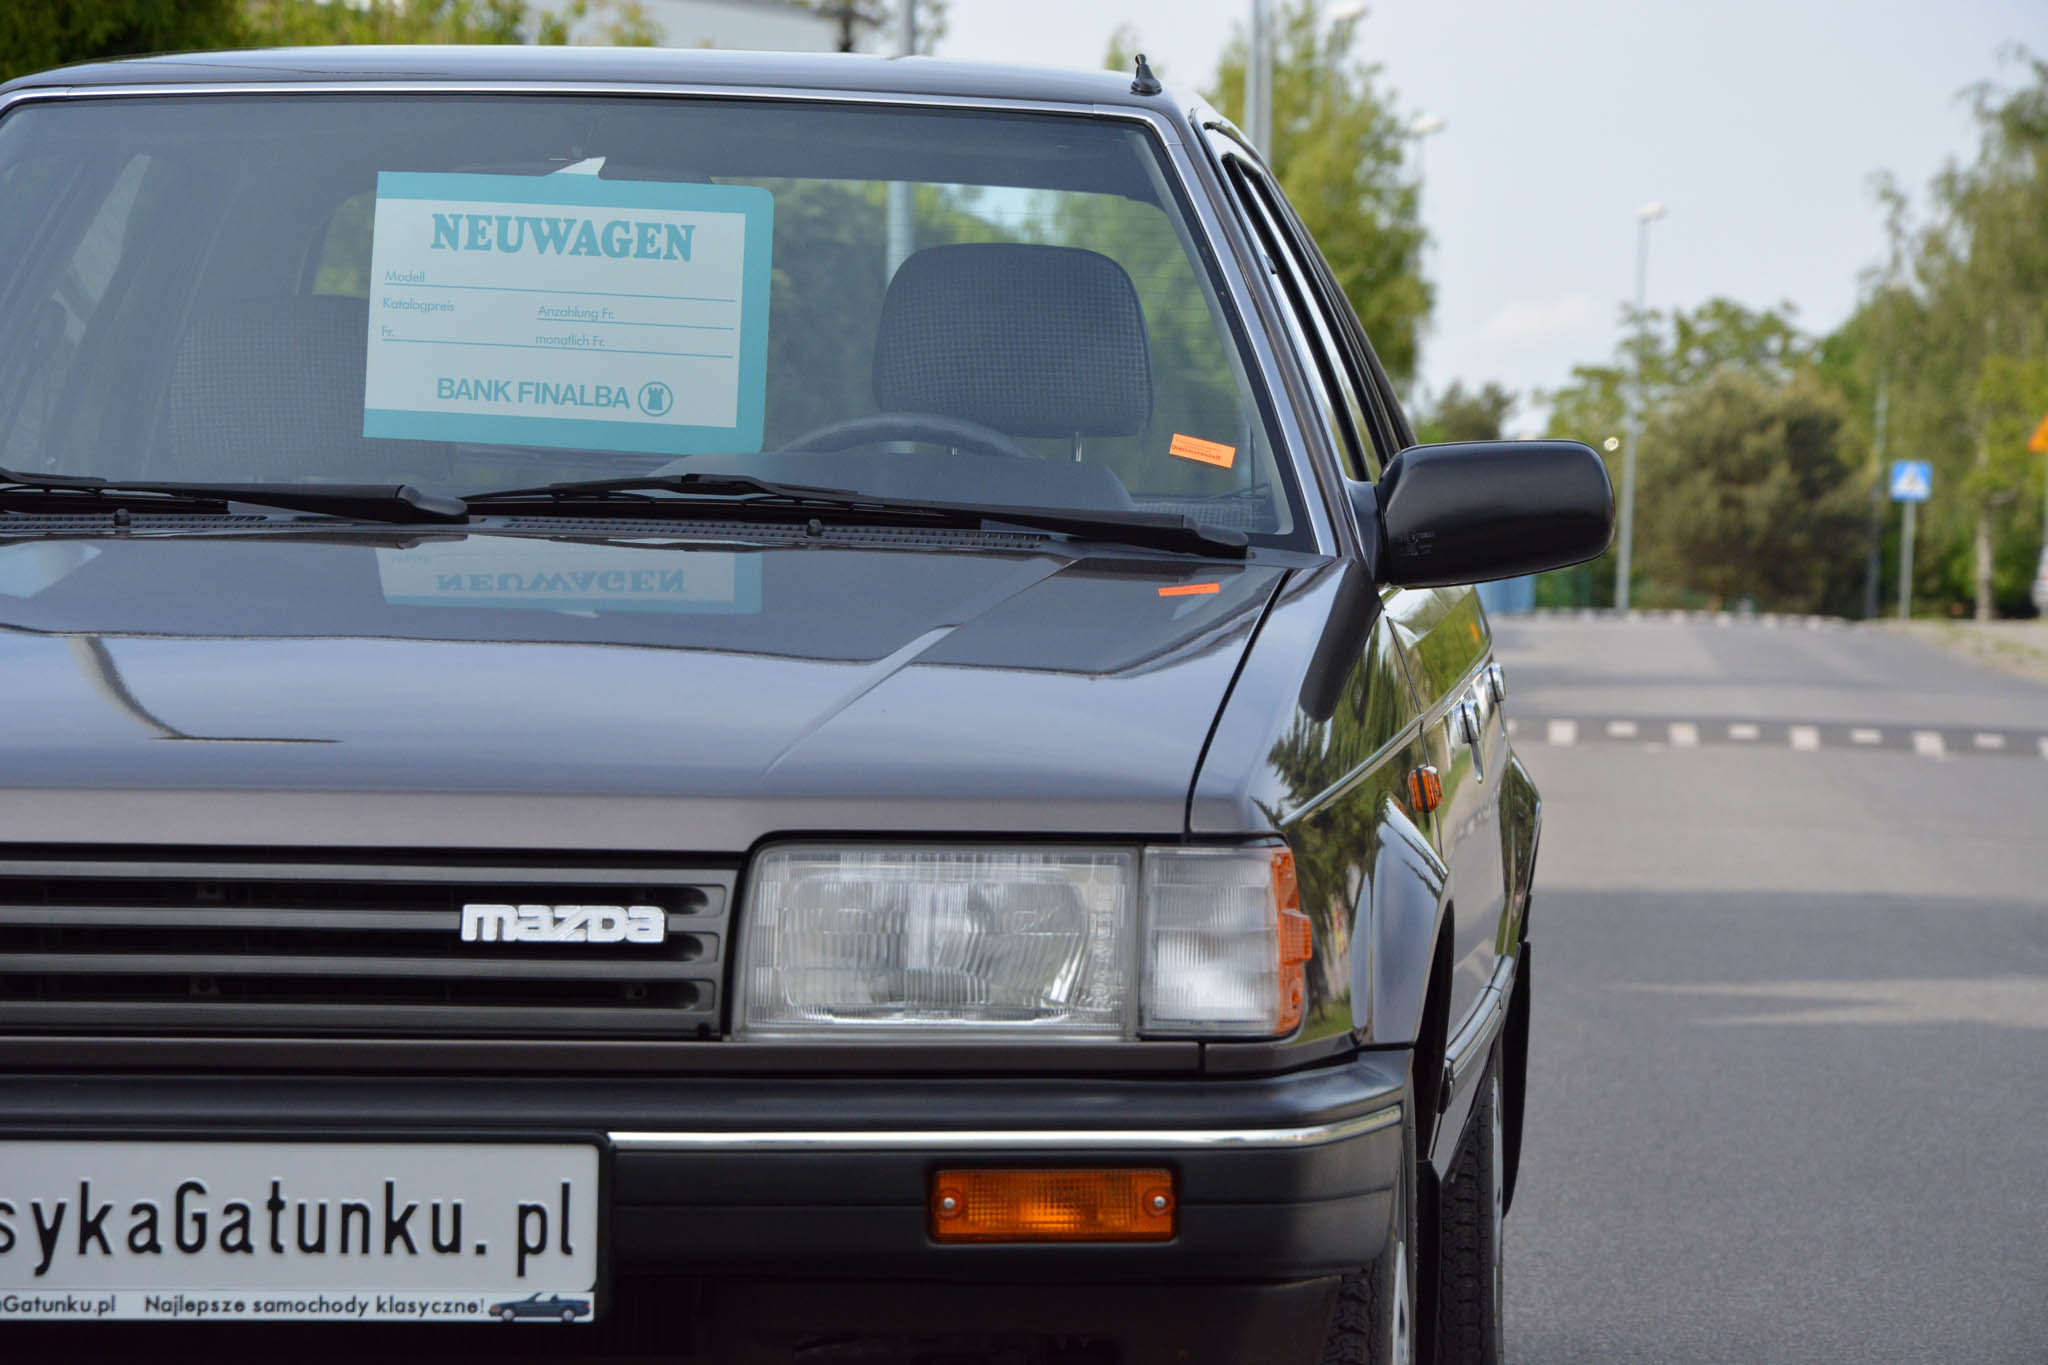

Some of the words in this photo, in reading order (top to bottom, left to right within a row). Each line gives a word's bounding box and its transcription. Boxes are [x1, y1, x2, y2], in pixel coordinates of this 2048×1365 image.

[430, 212, 696, 263] NEUWAGEN
[384, 270, 425, 283] Modell
[382, 297, 455, 313] Katalogpreis
[537, 304, 599, 321] Anzahlung
[381, 325, 395, 338] Fr.
[535, 334, 590, 347] monatlich
[437, 377, 512, 403] BANK
[517, 380, 631, 410] FINALBA
[0, 1294, 116, 1317] Gatunku.pl
[145, 1295, 246, 1317] Najlepsze
[253, 1294, 369, 1318] samochody
[376, 1294, 485, 1318] klasyczne!
